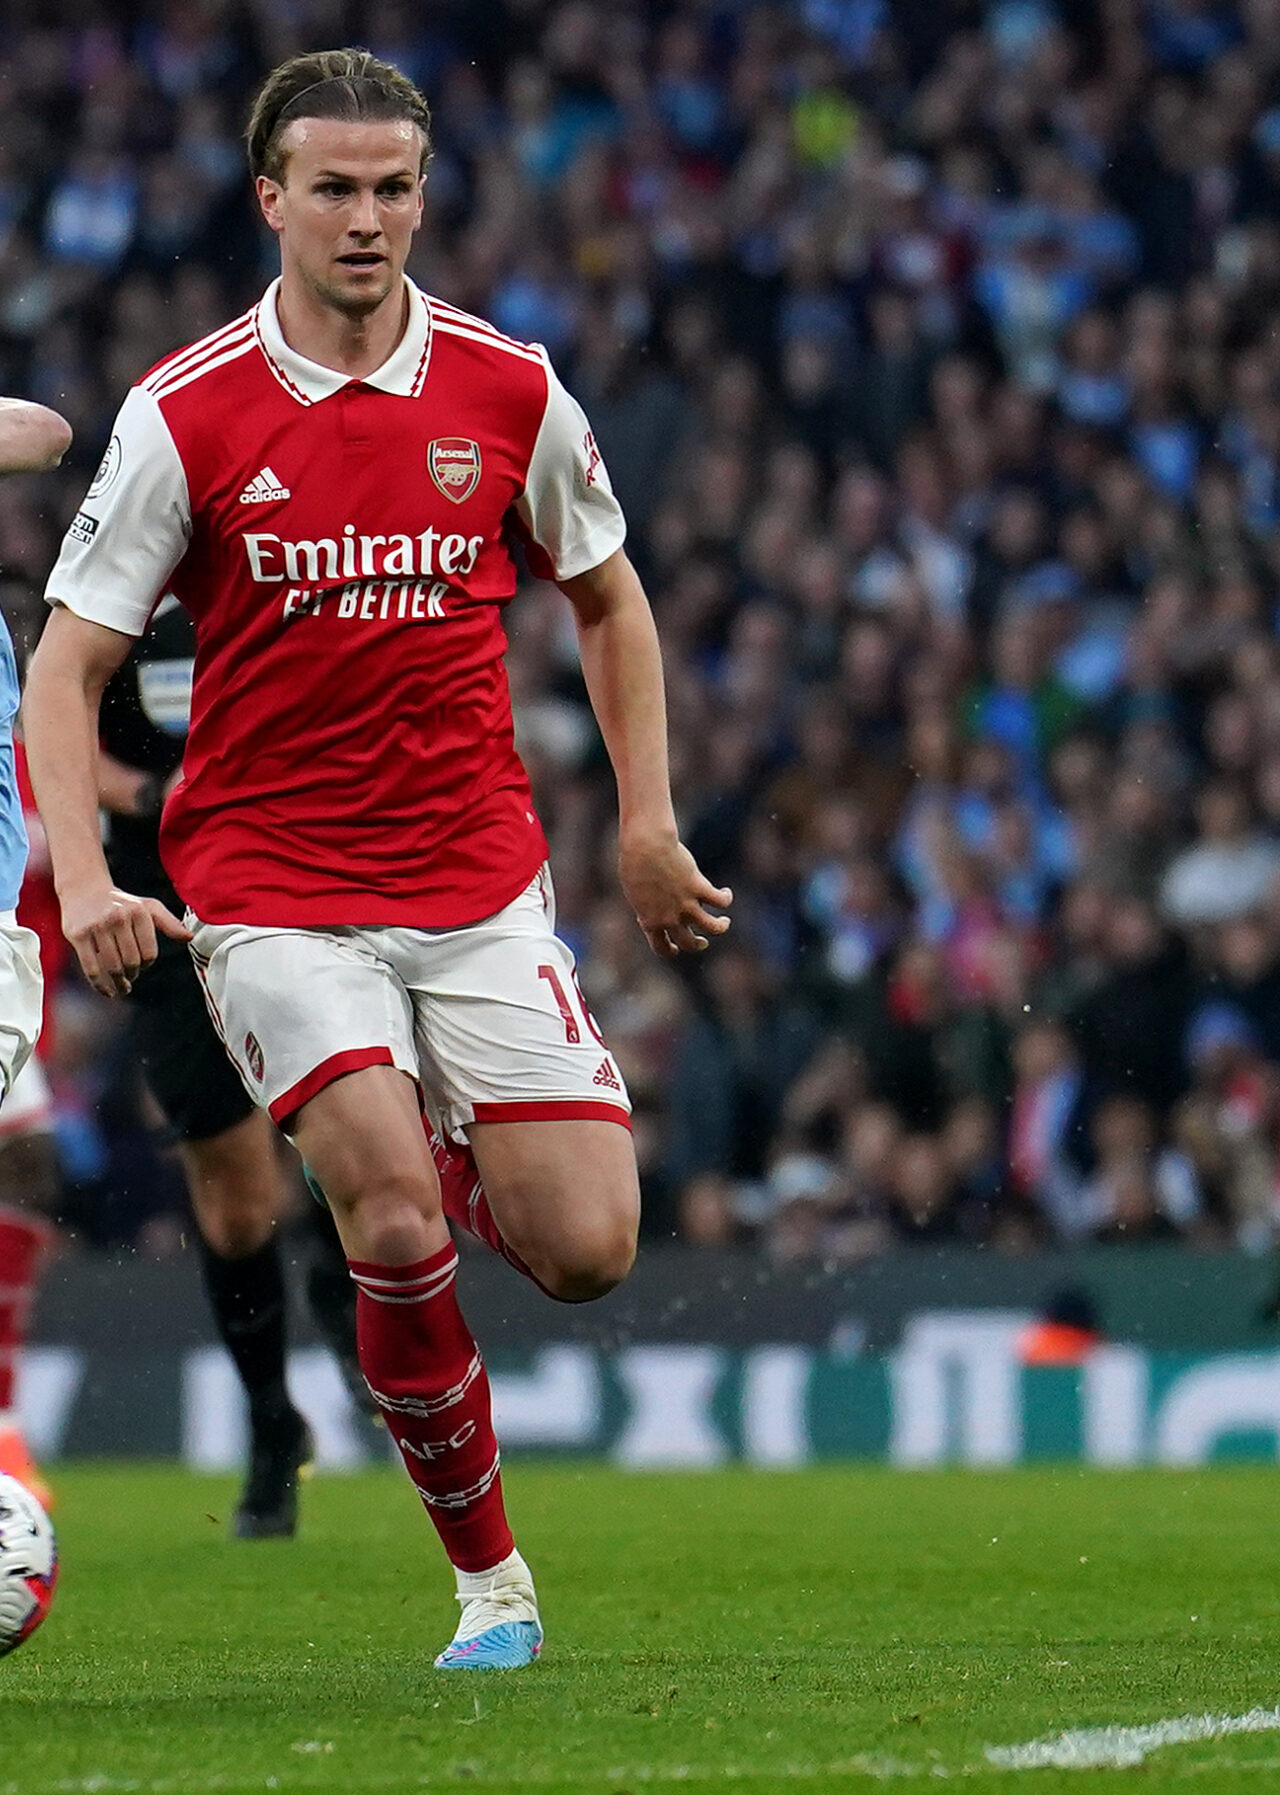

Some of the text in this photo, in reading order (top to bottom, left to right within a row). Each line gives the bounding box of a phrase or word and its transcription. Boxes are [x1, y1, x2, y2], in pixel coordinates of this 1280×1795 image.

[435, 448, 473, 458] Arsenal
[239, 488, 291, 504] adidas
[242, 524, 484, 582] Emirates
[337, 579, 449, 619] BETTER
[400, 1419, 476, 1460] AFC
